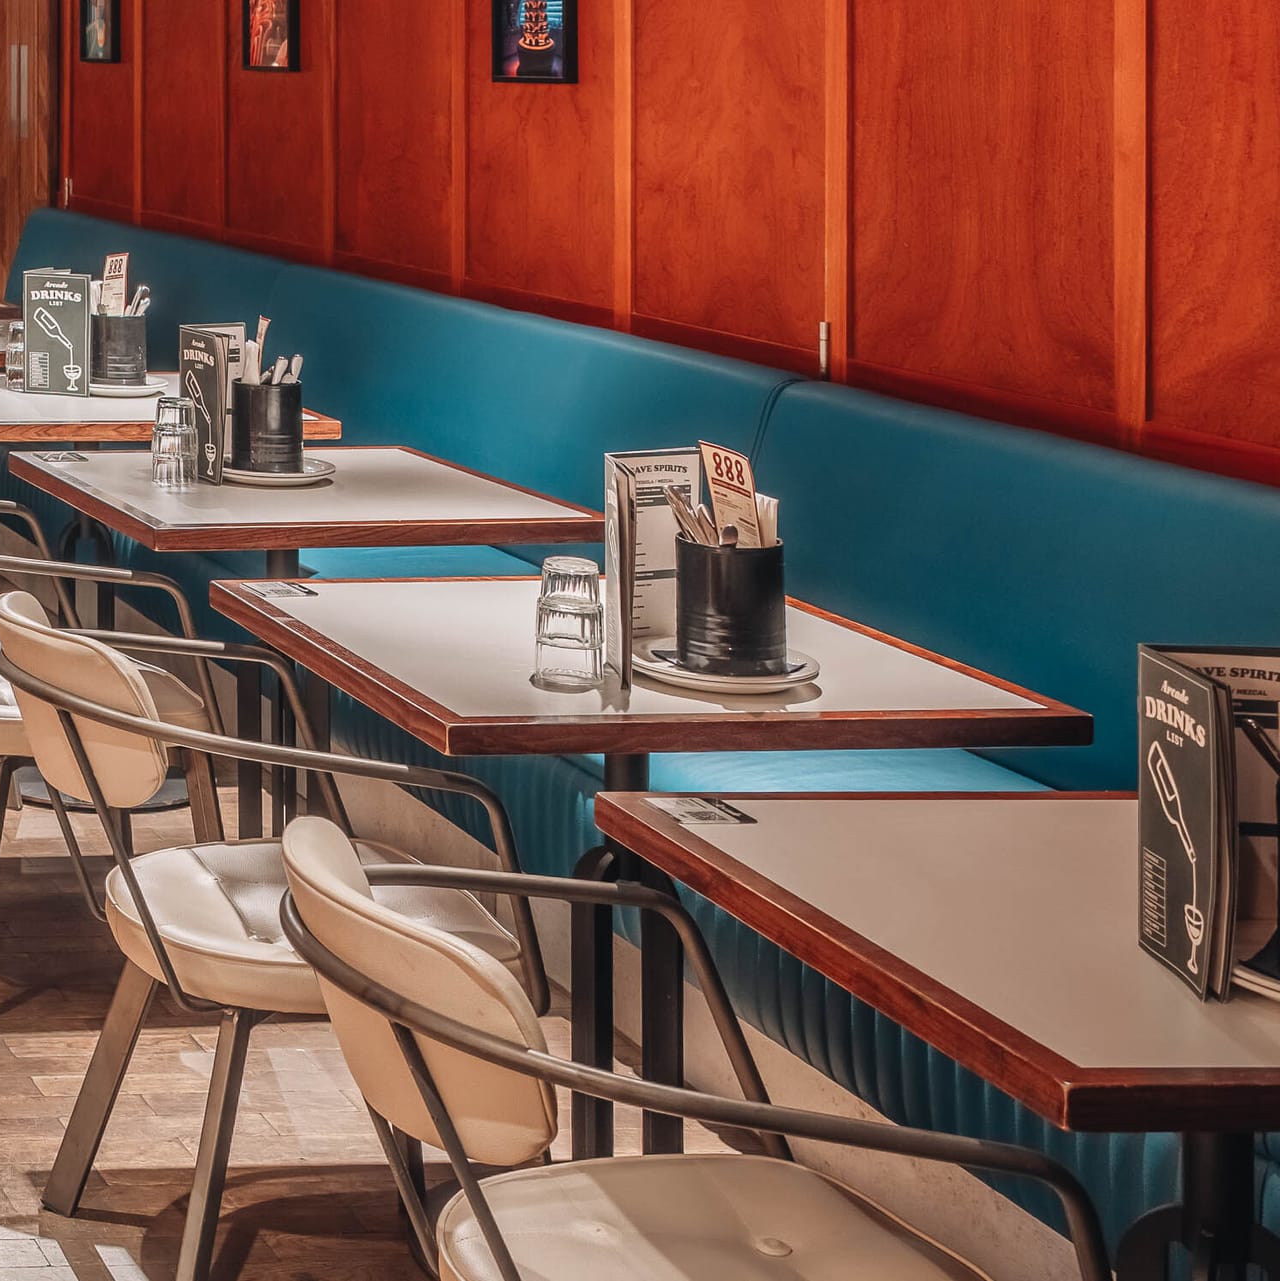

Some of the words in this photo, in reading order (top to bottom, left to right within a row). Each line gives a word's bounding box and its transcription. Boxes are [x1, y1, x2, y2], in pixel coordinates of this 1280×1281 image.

[108, 258, 123, 274] 888
[44, 280, 69, 289] Arcade
[30, 290, 82, 303] DRINKS
[183, 349, 215, 367] DRINKS
[653, 464, 688, 474] SPIRITS
[712, 452, 745, 486] 888
[1229, 667, 1280, 682] SPIRIT
[1160, 679, 1189, 705] Arcade
[1145, 696, 1206, 748] DRINKS
[1166, 730, 1184, 748] LIST
